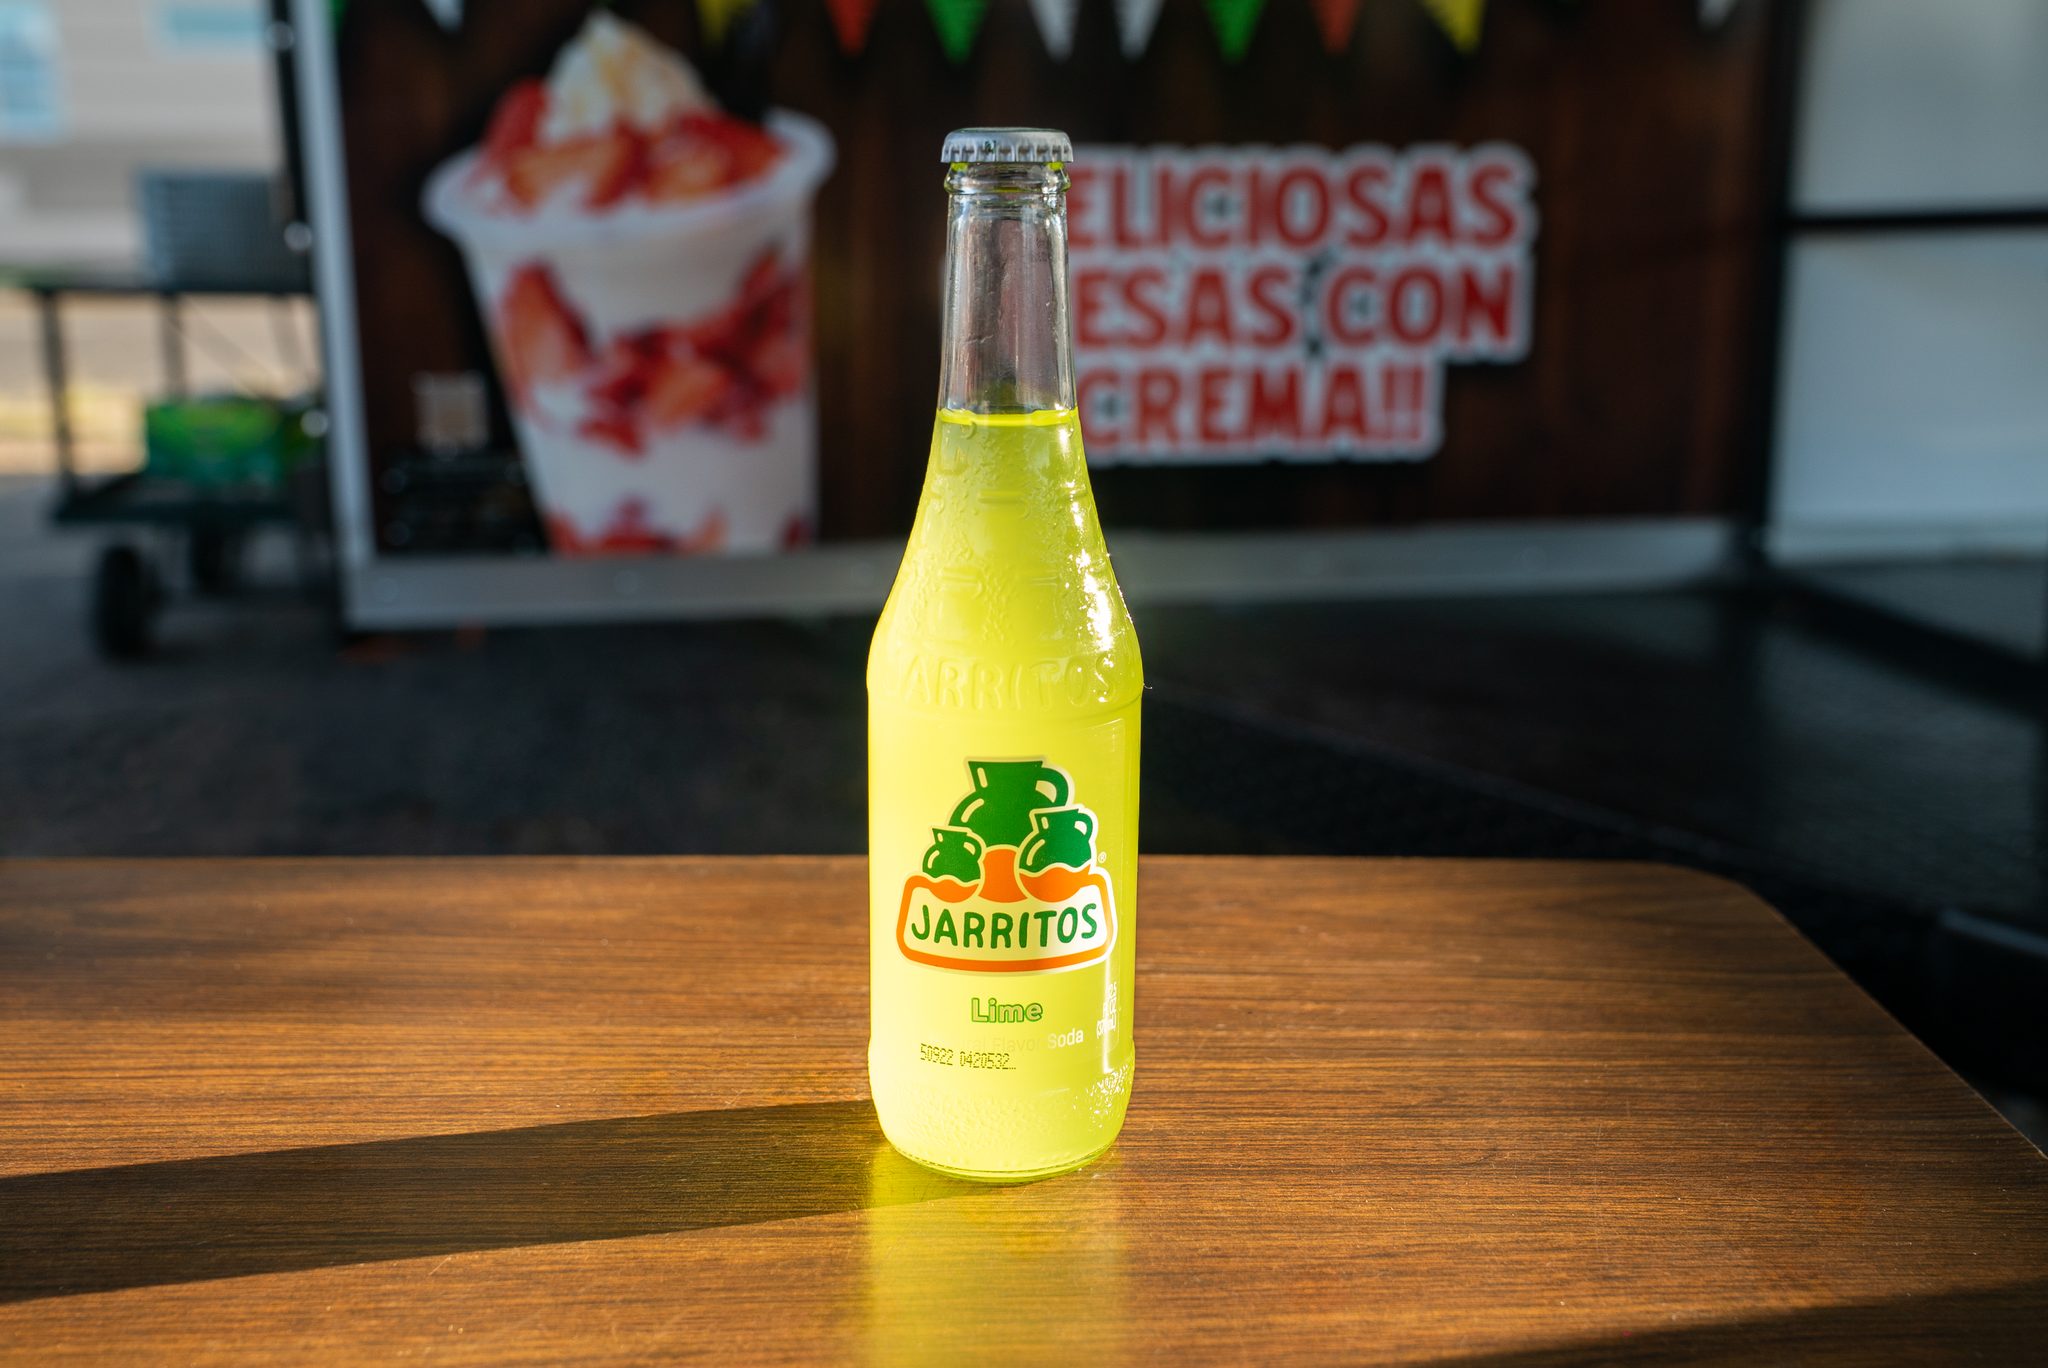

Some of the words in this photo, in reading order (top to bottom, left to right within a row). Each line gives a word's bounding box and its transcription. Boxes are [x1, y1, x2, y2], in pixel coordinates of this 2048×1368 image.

[1066, 163, 1518, 249] ELICIOSAS
[1075, 265, 1298, 350] ESAS
[1324, 264, 1517, 348] CON
[1077, 362, 1427, 447] CREMA!!
[901, 655, 1116, 710] ARRITOS
[911, 903, 1098, 949] JARRITOS
[971, 997, 1044, 1023] Lime
[920, 1042, 954, 1066] 50922
[1047, 1027, 1085, 1049] Soda
